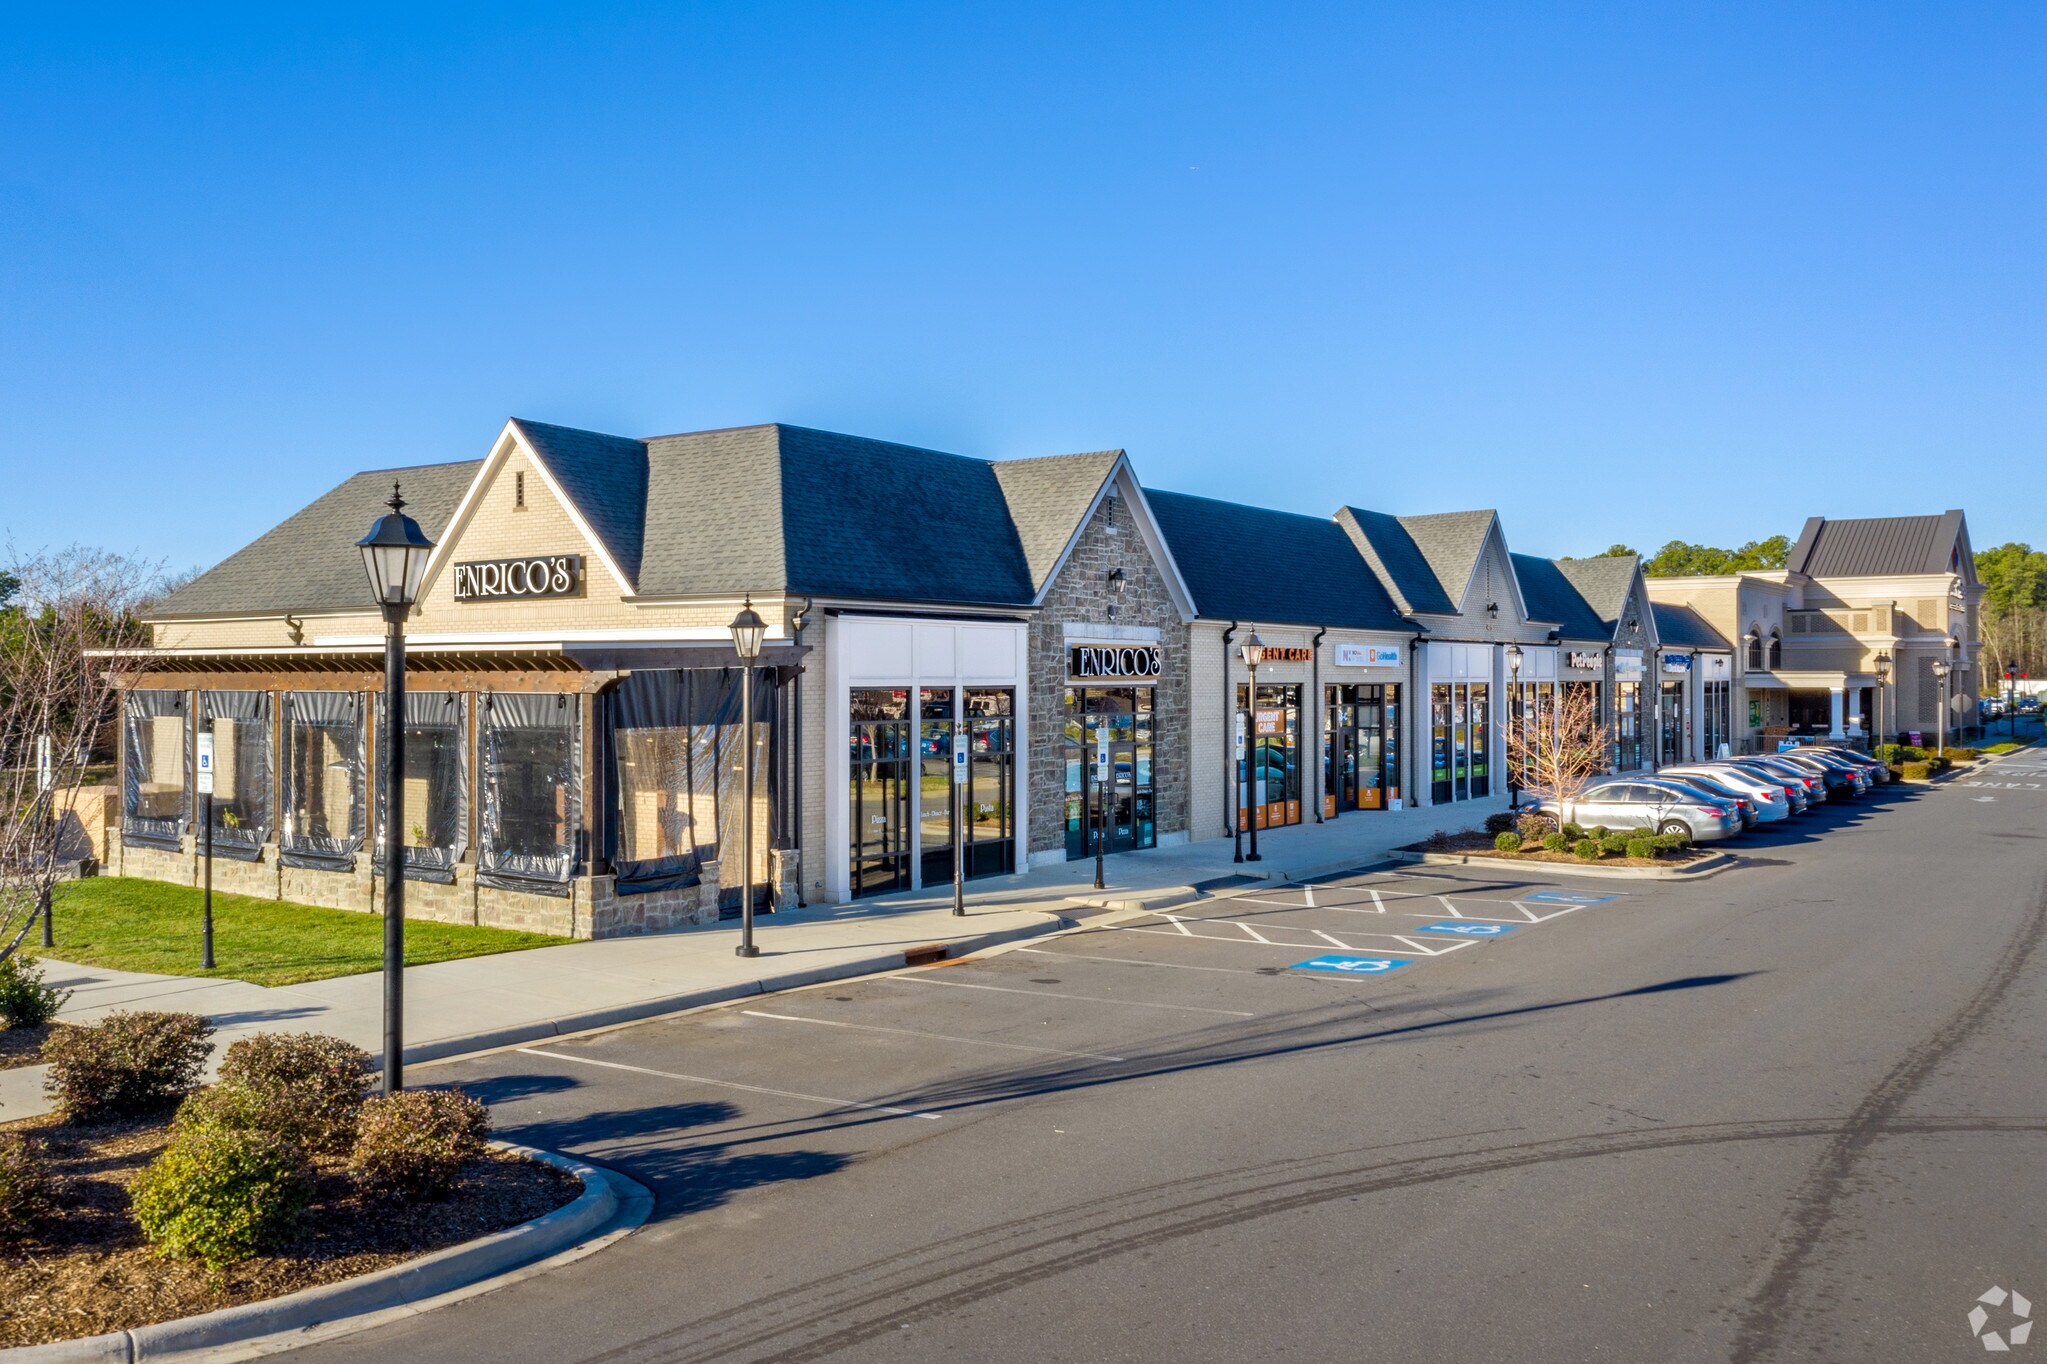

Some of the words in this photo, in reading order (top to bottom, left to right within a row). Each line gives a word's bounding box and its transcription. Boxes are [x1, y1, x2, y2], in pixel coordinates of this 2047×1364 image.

[454, 557, 570, 598] ENRICO'S
[1080, 647, 1161, 676] ENRICO'S
[1289, 648, 1312, 661] CARE
[1258, 722, 1275, 733] CARE
